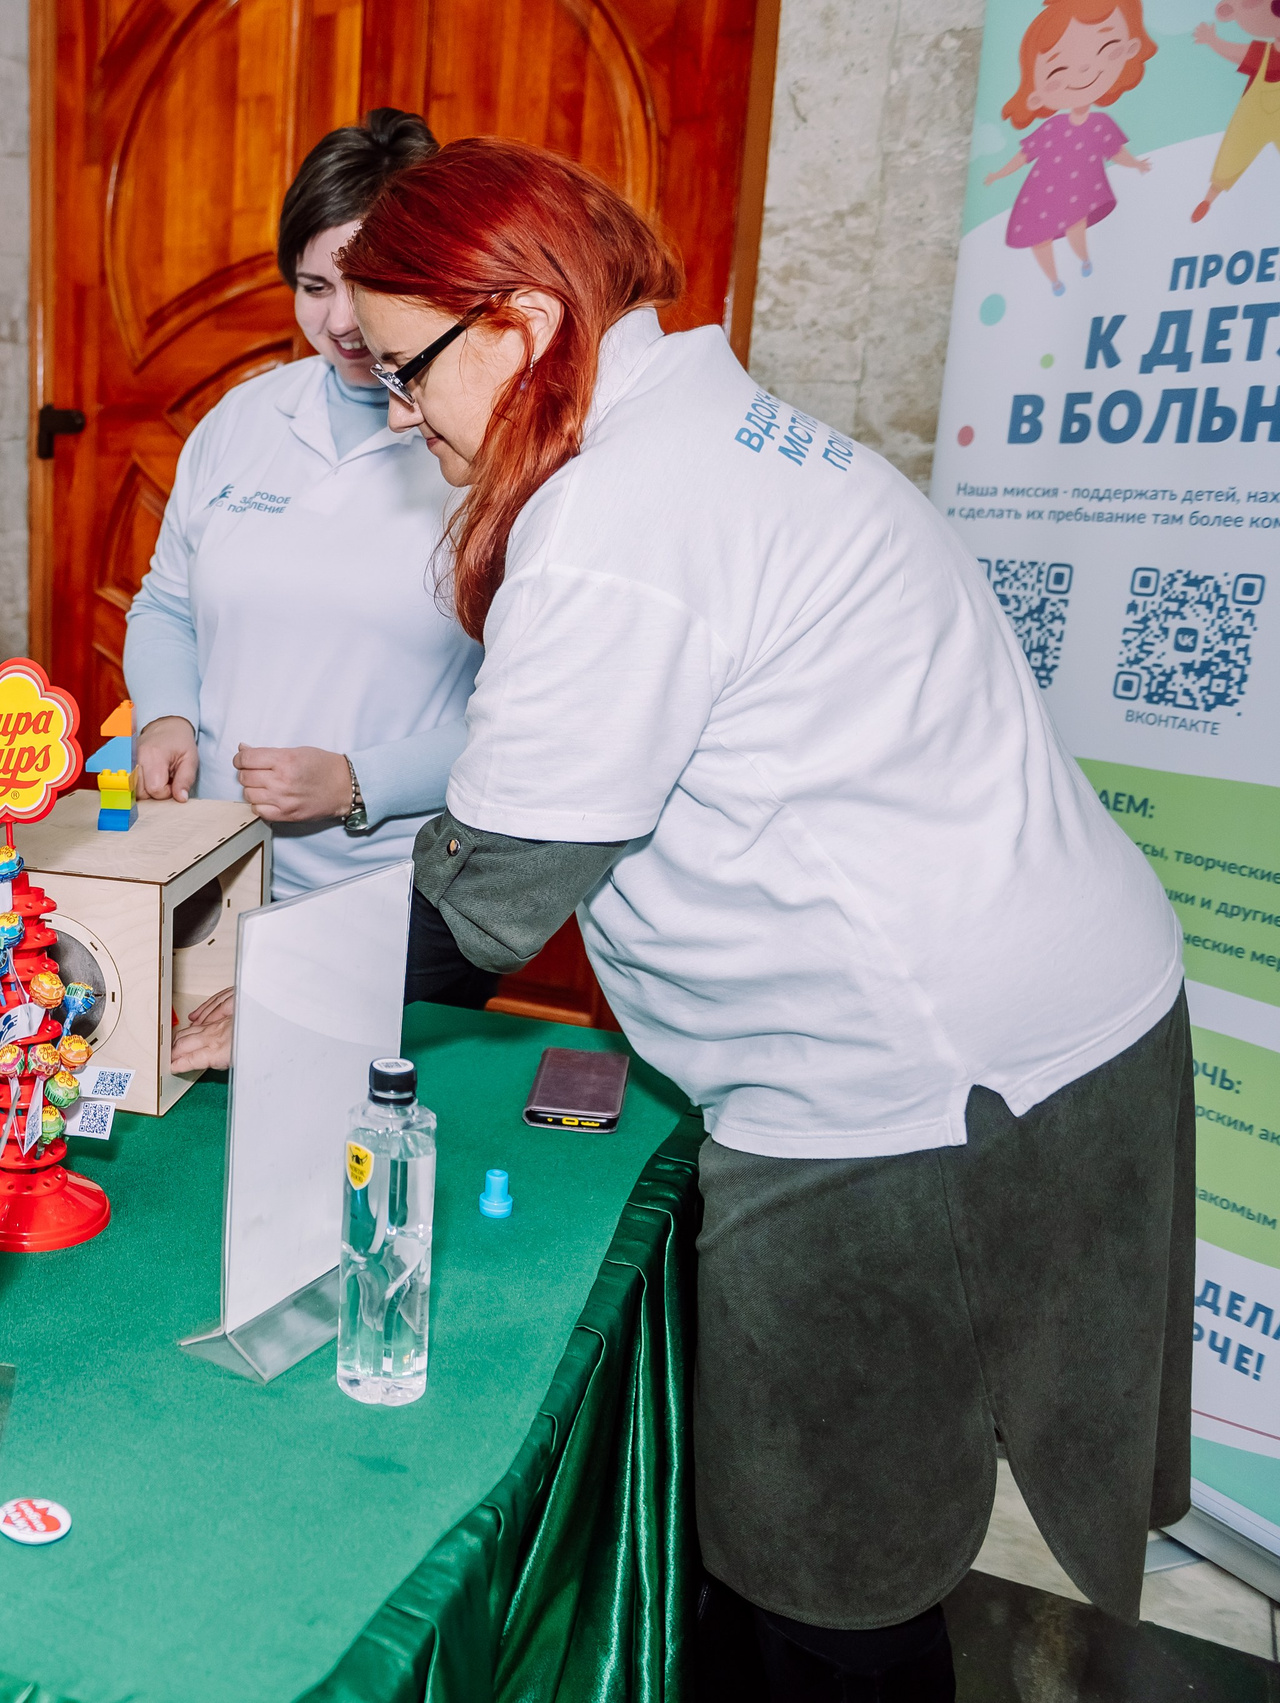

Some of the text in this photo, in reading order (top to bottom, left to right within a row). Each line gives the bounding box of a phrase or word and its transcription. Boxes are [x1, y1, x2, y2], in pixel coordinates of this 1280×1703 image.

[1169, 246, 1280, 292] ПРОЕ
[1084, 302, 1280, 375] К ДЕТ
[1007, 385, 1280, 445] В БОЛЬН
[956, 483, 998, 497] Наша
[1003, 487, 1059, 499] миссия
[1071, 488, 1177, 503] поддержать
[1181, 486, 1241, 505] детей,
[1246, 490, 1280, 503] нах
[947, 508, 956, 518] и
[959, 507, 1022, 520] сделать
[1026, 509, 1044, 520] их
[1048, 507, 1147, 524] пребывание
[1152, 513, 1184, 525] там
[1189, 511, 1244, 527] более
[1125, 709, 1221, 735] ВКОНТАКТЕ
[1099, 789, 1155, 819] АЕМ:
[1136, 842, 1168, 861] сы,
[1201, 897, 1212, 910] и
[1183, 932, 1245, 959] ческие
[1195, 1105, 1280, 1146] рским ак
[1196, 1187, 1277, 1230] акомым
